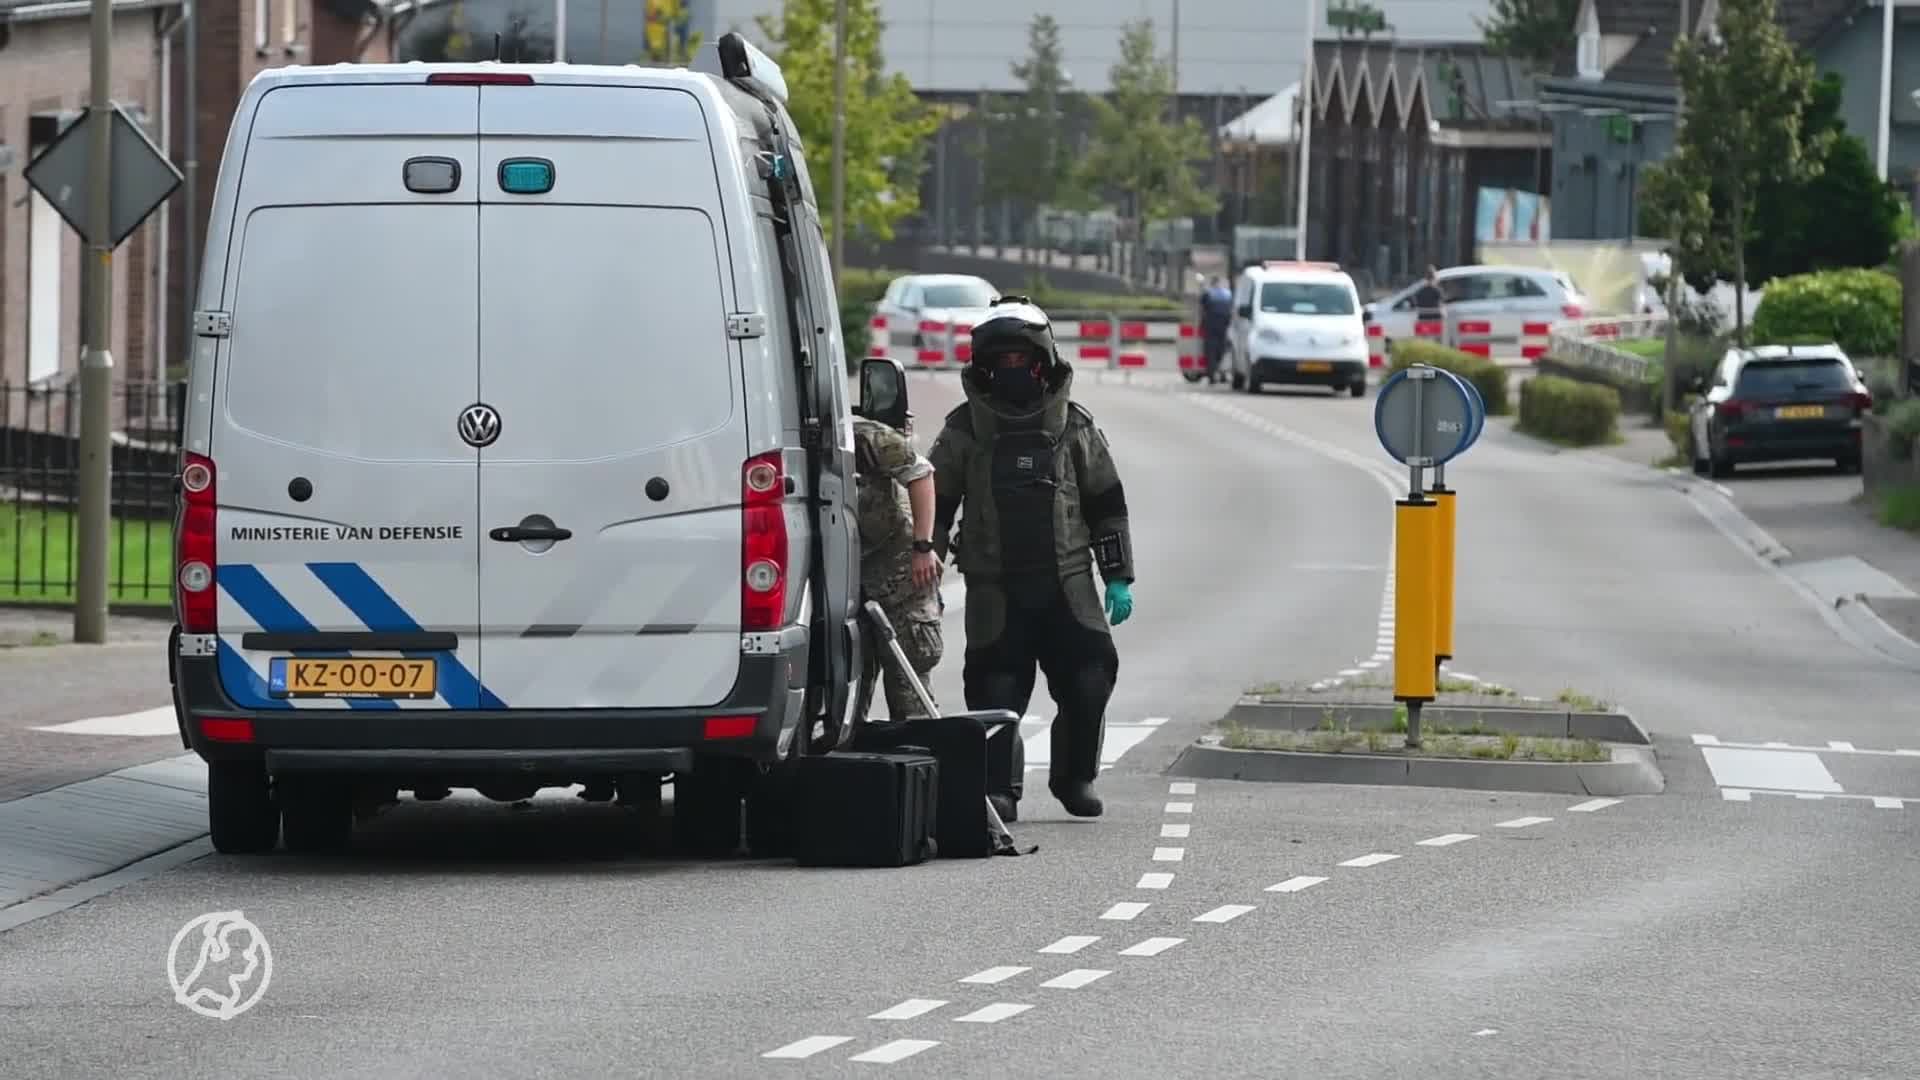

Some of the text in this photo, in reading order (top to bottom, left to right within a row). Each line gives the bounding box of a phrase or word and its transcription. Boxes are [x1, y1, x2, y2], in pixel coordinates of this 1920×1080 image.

[231, 525, 463, 541] MINISTERIE VAN DEFENSIE
[294, 663, 424, 688] KZ-00-07
